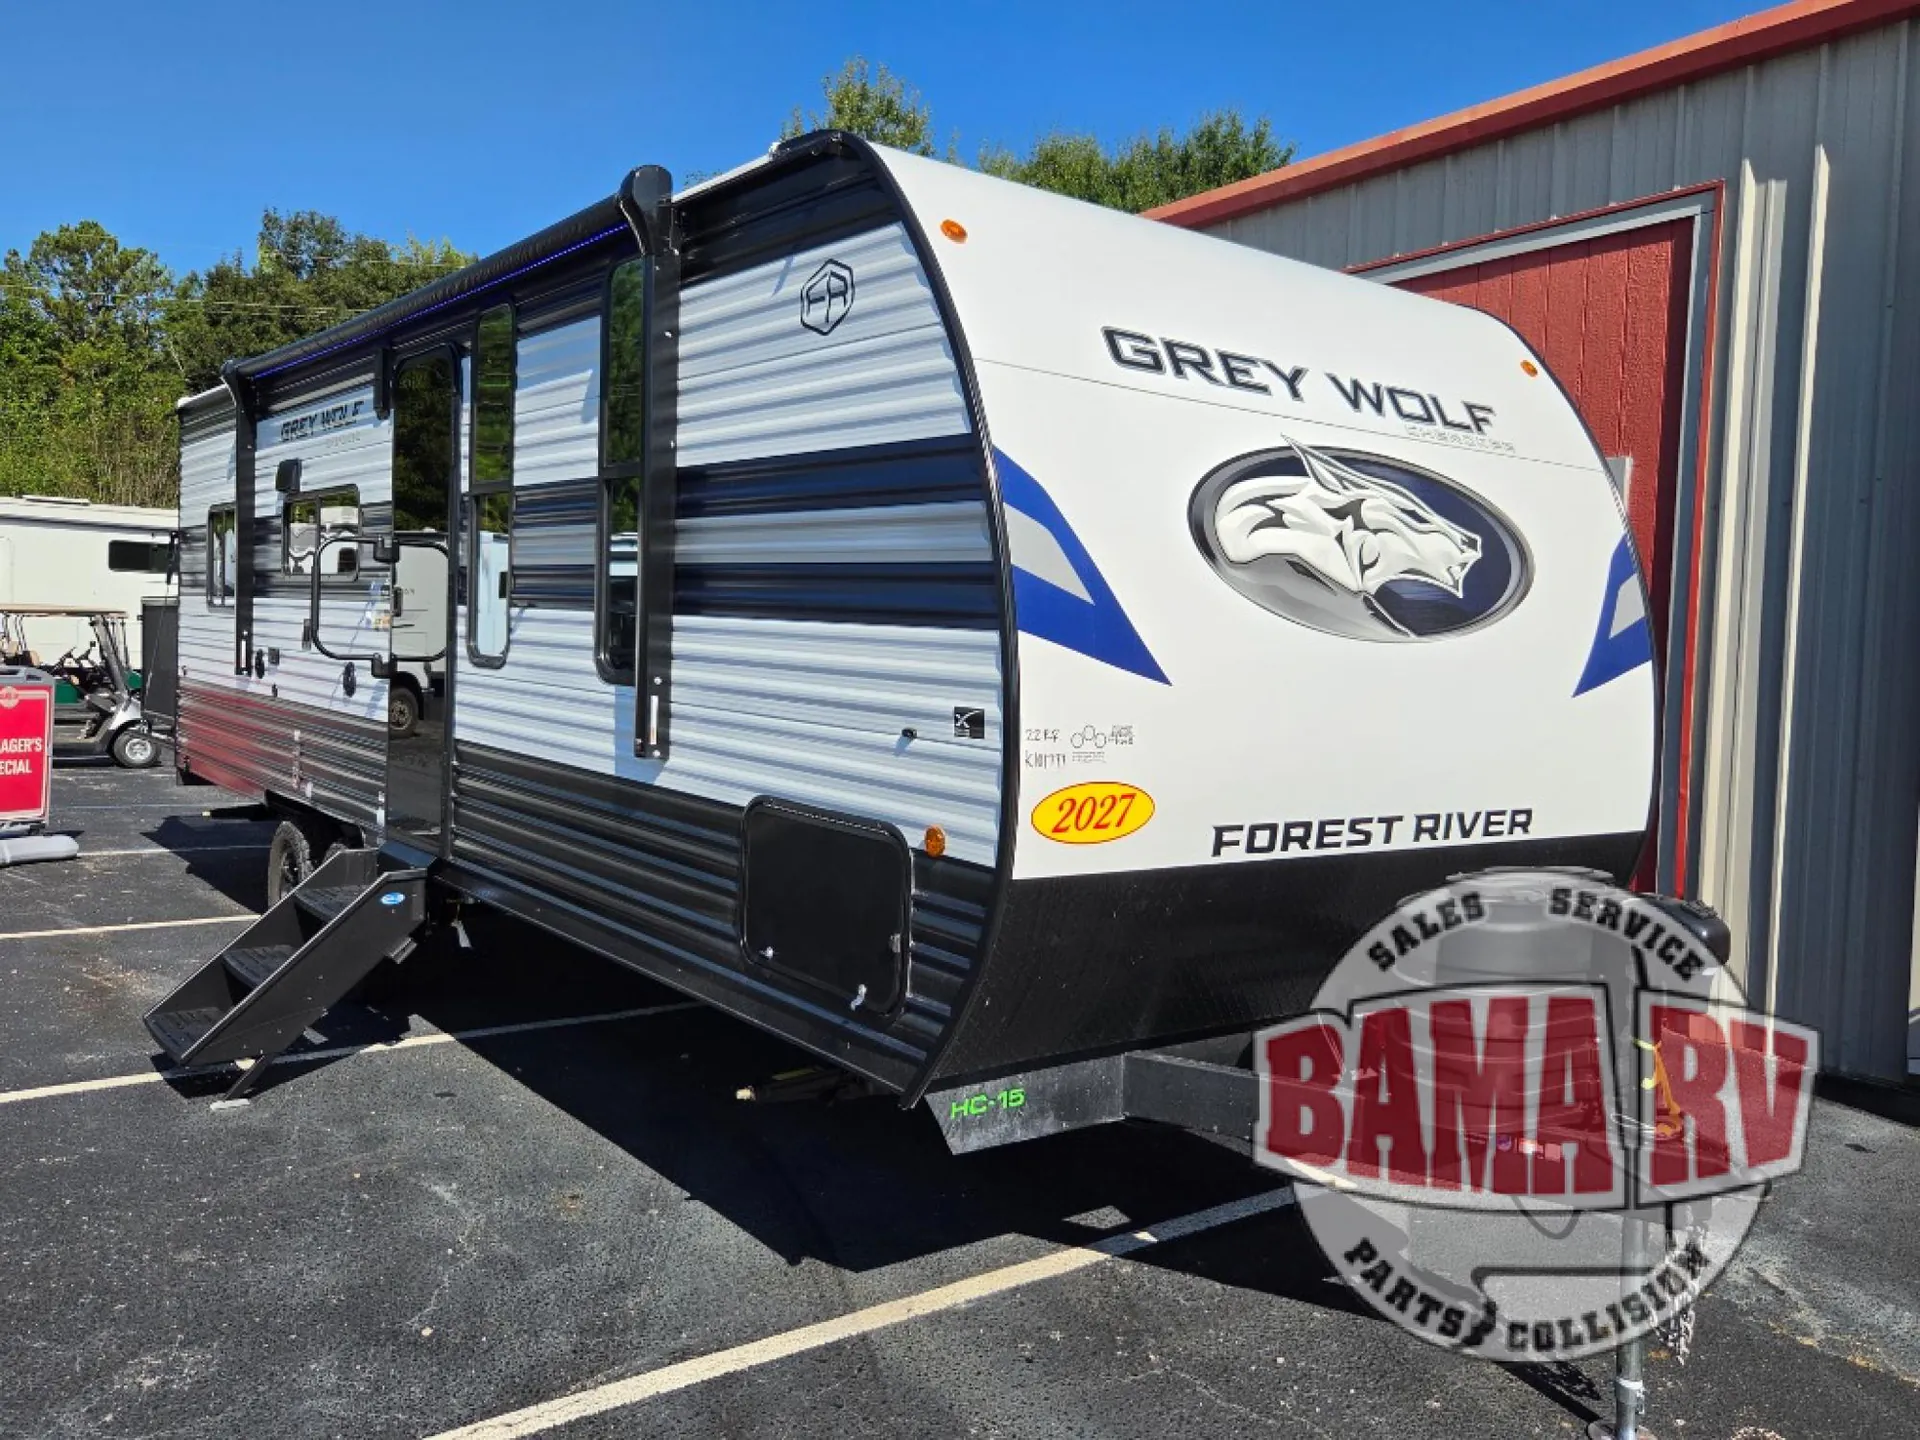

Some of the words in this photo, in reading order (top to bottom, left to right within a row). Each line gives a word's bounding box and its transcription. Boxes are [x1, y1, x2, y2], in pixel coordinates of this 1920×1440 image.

[1102, 325, 1309, 402] GREY
[1325, 372, 1497, 435] WOLF
[281, 414, 318, 441] GREY
[1052, 793, 1137, 833] 2027
[1211, 815, 1404, 858] FOREST
[1413, 807, 1533, 843] RIVER
